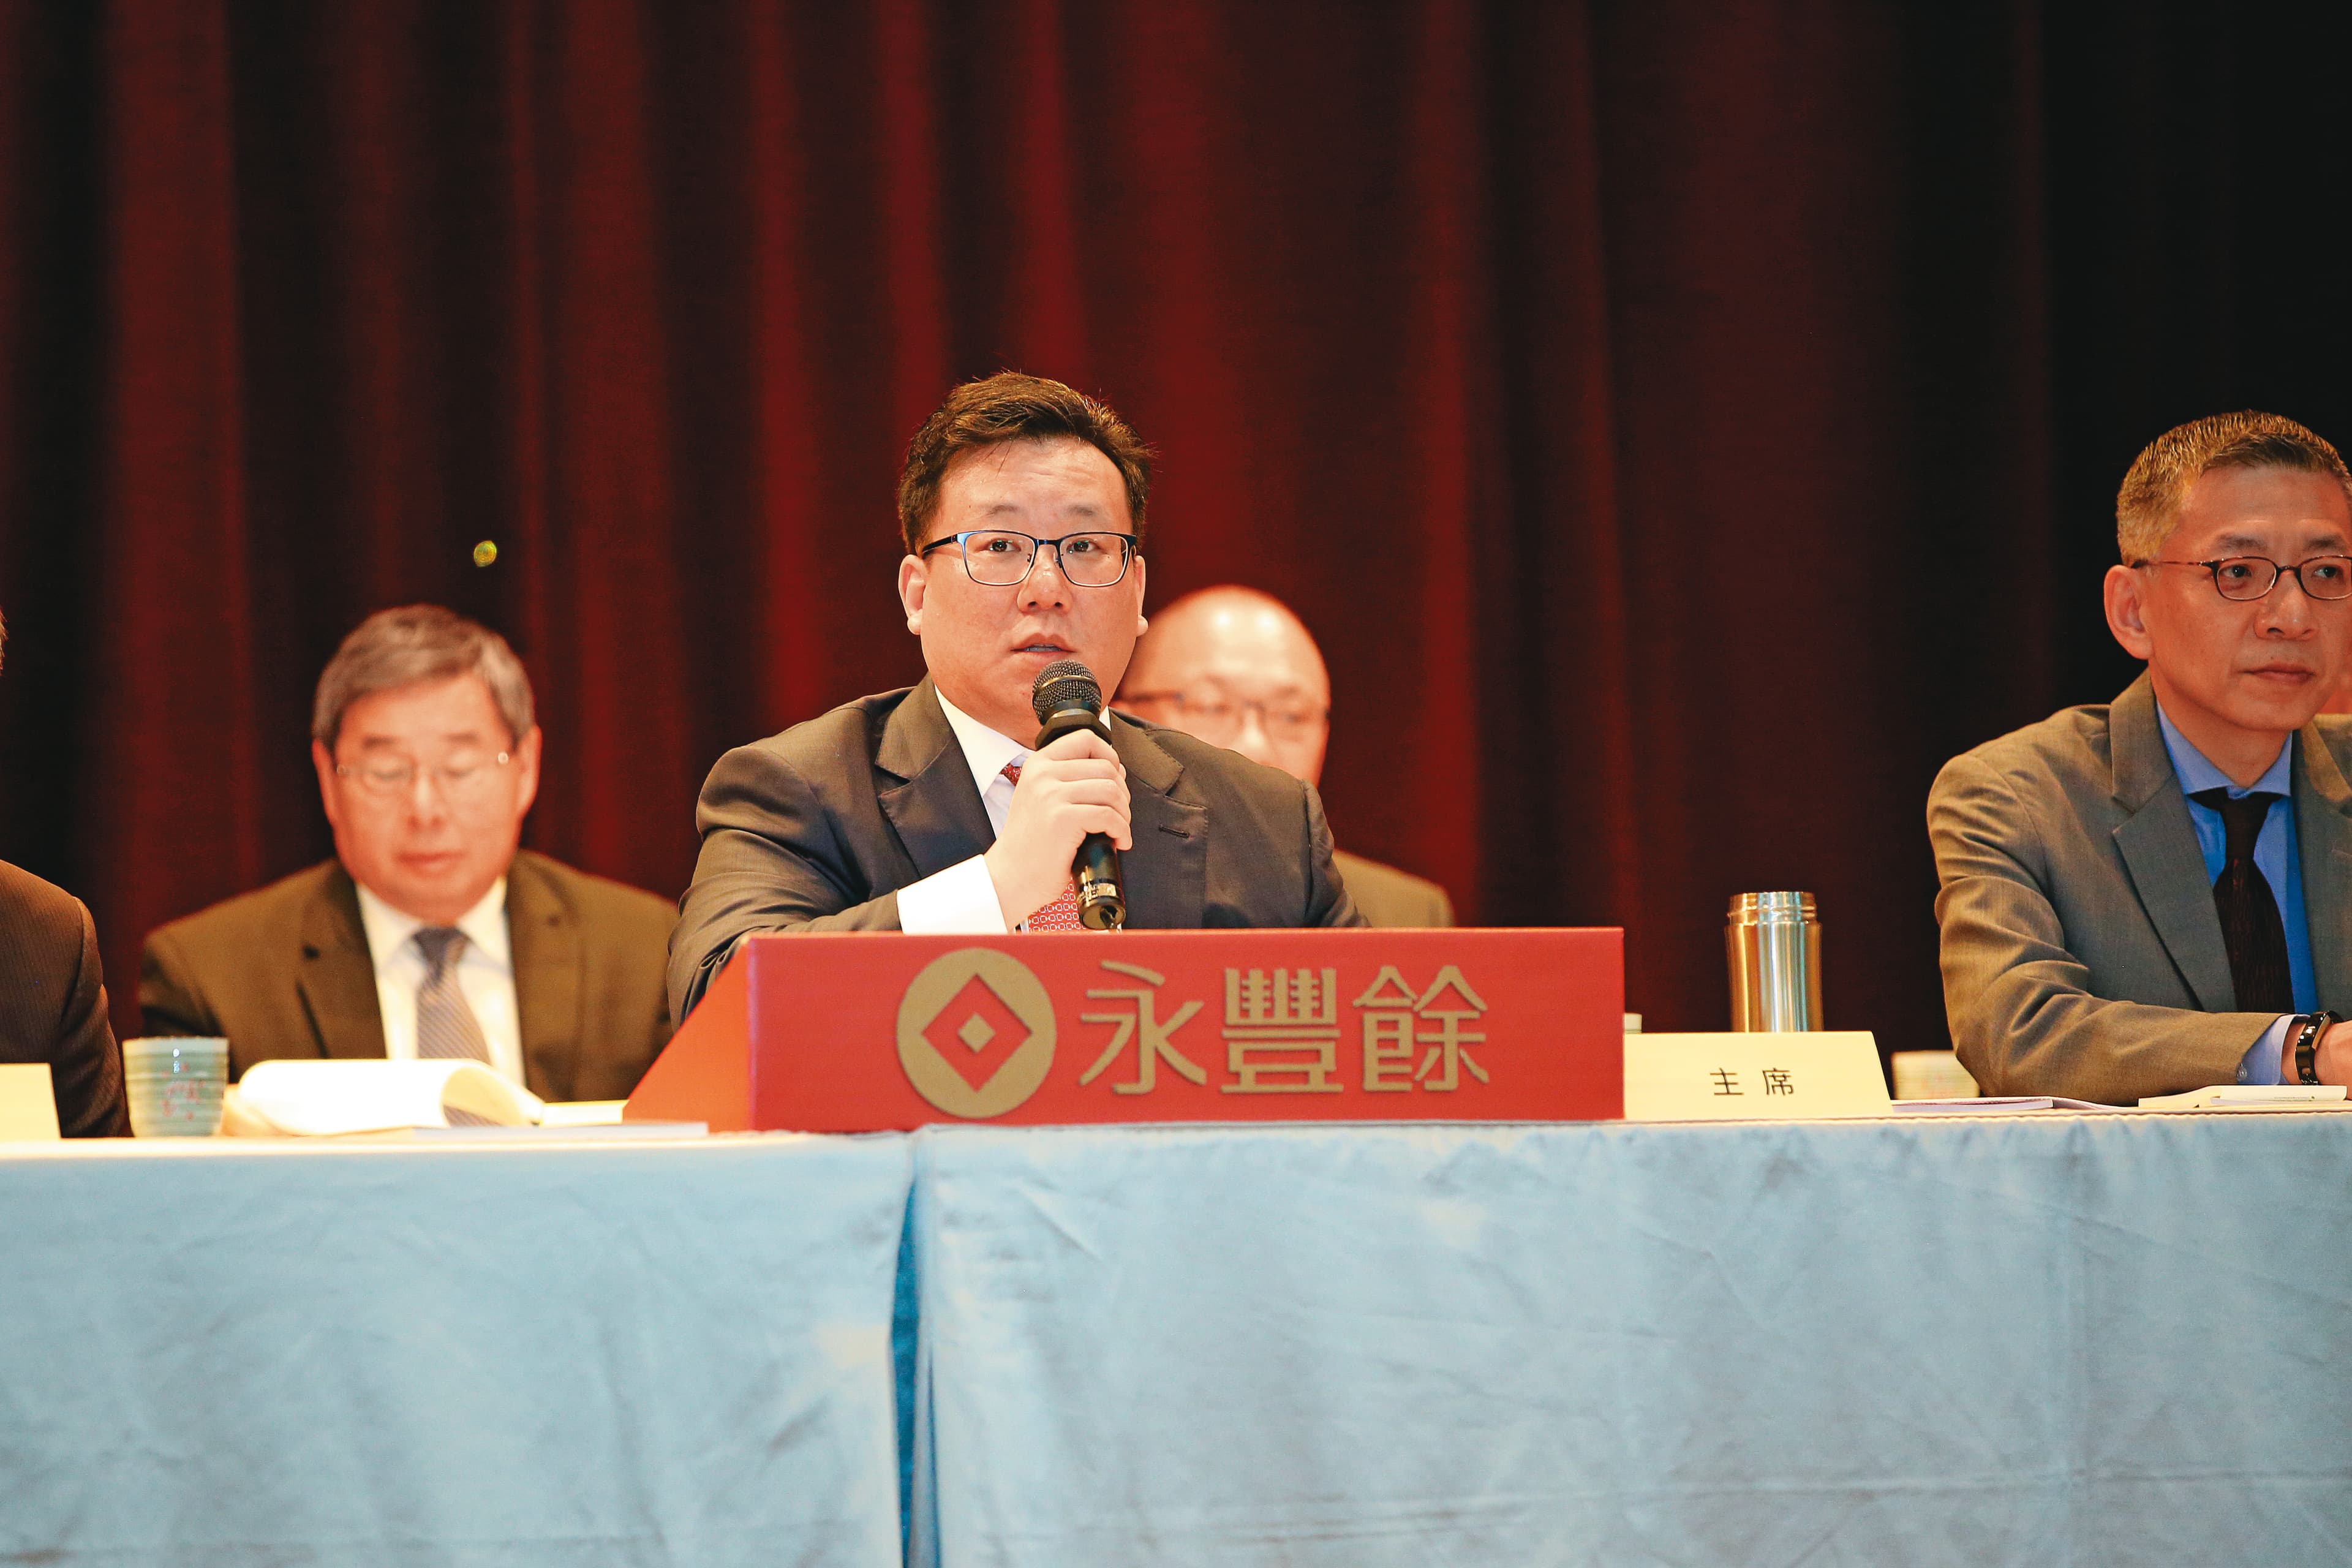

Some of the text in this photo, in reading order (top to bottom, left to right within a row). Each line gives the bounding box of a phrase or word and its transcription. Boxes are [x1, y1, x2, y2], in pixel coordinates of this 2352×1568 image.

[1079, 959, 1490, 1095] 永豐餘
[1710, 1068, 1795, 1096] 主席
